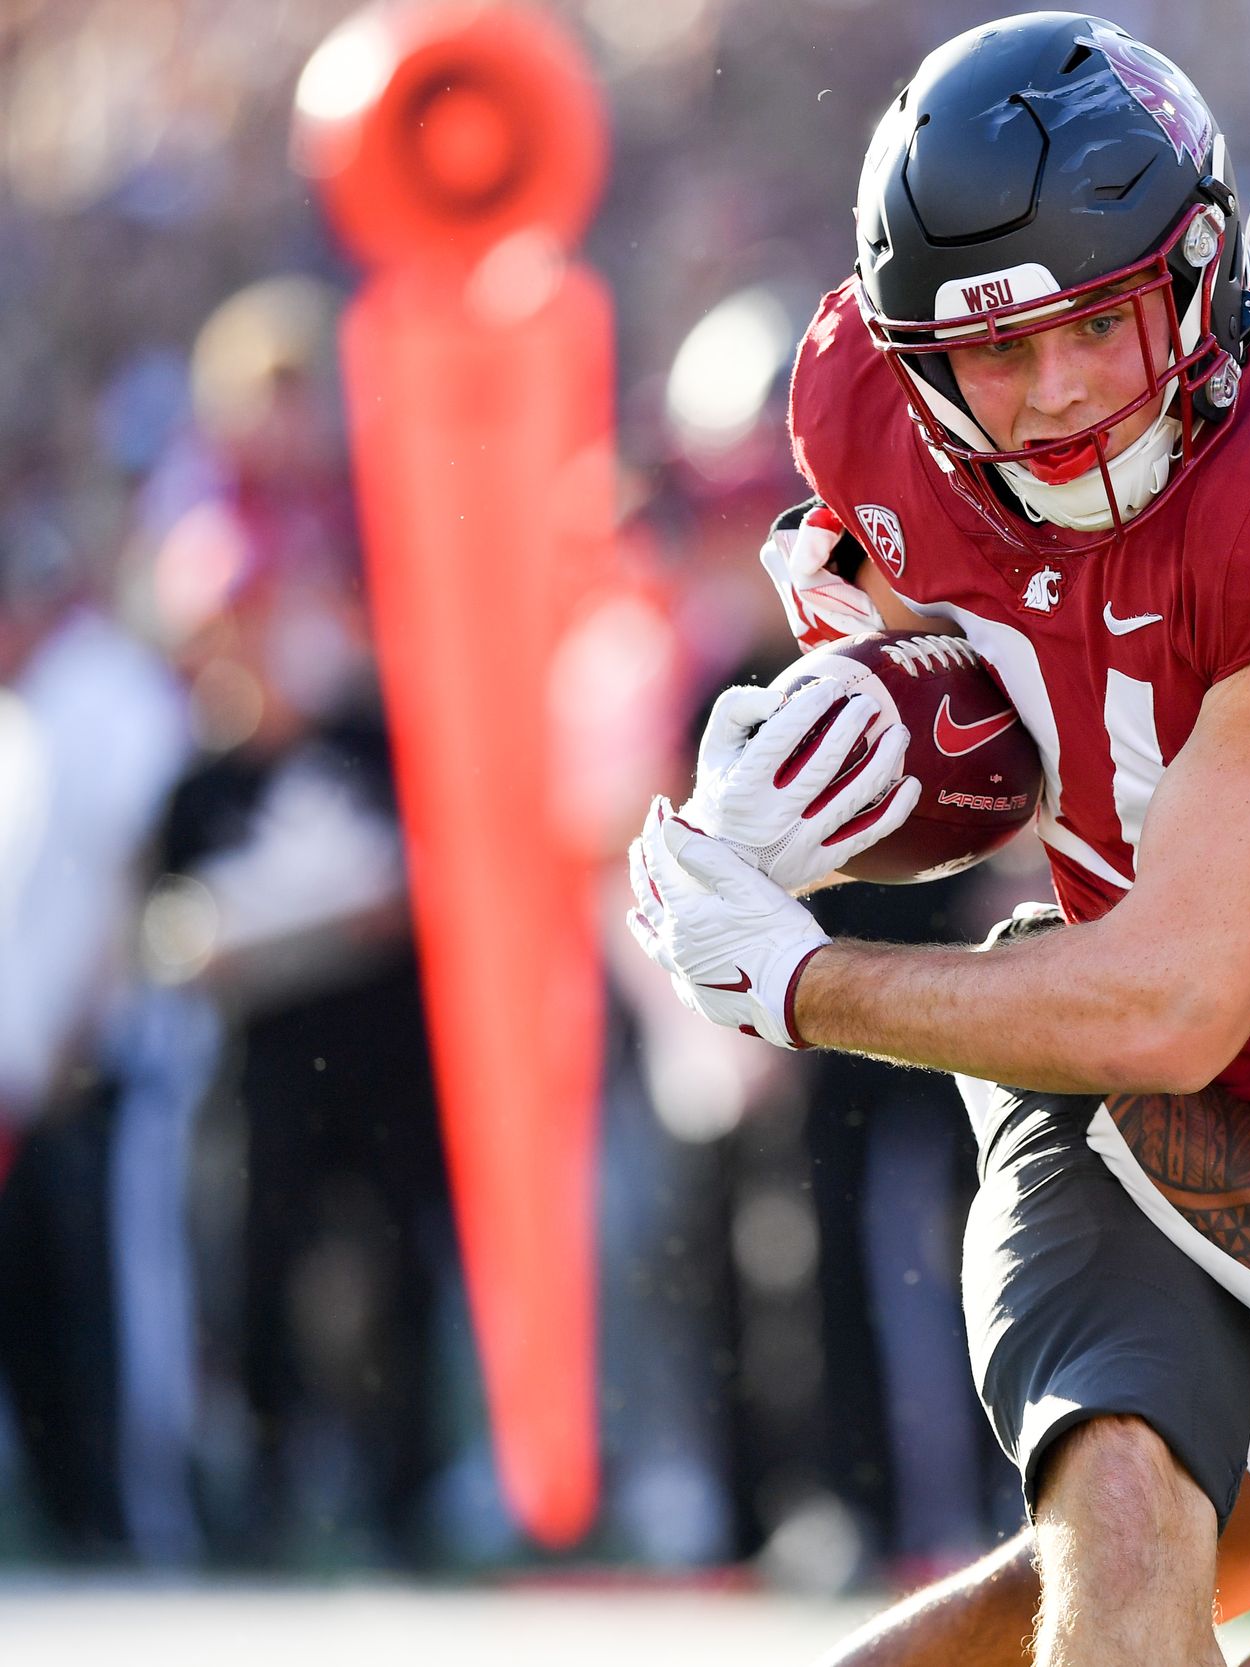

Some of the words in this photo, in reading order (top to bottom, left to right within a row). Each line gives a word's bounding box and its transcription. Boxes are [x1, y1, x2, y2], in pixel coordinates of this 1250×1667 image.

[961, 278, 1013, 313] WSU
[858, 508, 902, 546] PAC
[877, 535, 901, 564] 12
[938, 789, 993, 810] VAPOR
